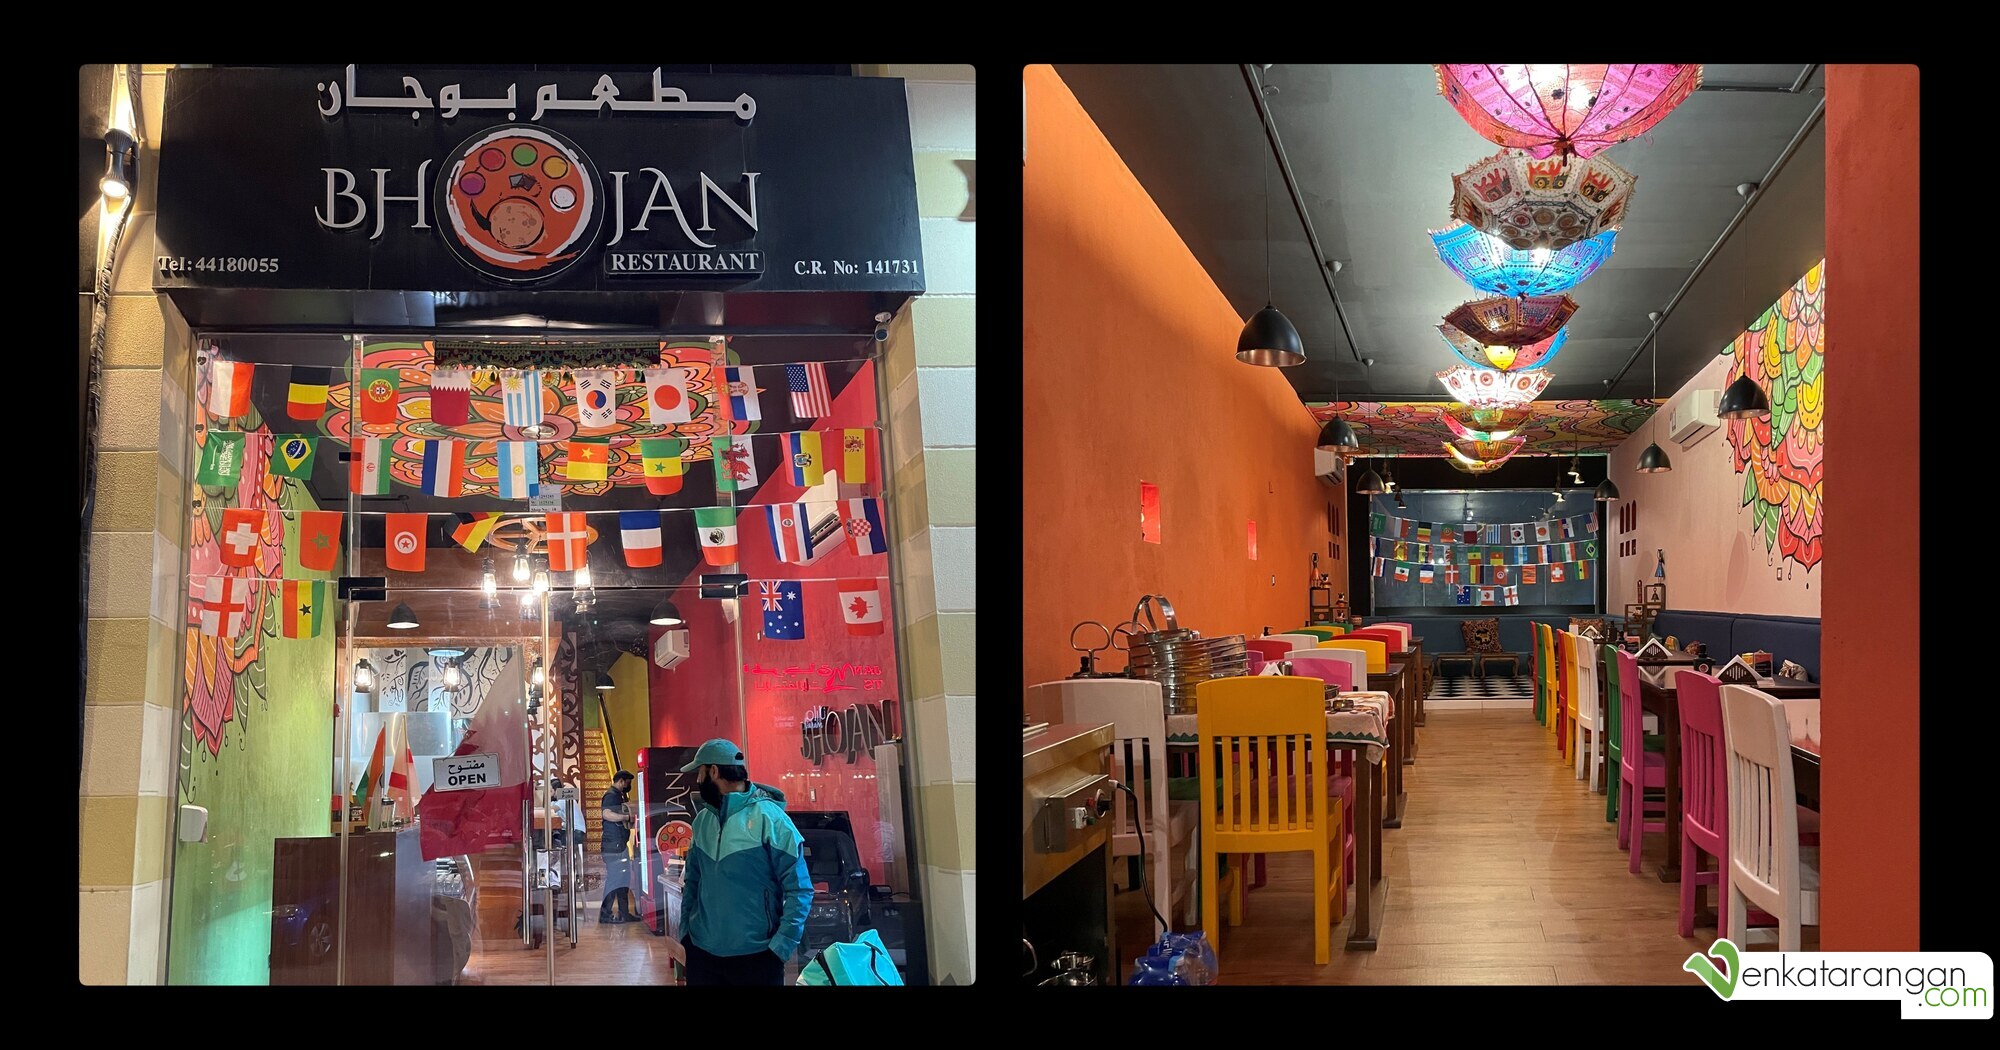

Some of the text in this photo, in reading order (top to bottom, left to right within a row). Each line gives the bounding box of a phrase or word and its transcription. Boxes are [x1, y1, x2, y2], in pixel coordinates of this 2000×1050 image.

[317, 64, 757, 121] مطعم بوجان
[611, 252, 760, 272] RESTAURANT
[794, 259, 920, 275] C.R. No: 141731
[800, 700, 892, 767] BHOJAN
[447, 760, 485, 775] مفتوح
[448, 773, 487, 786] OPEN
